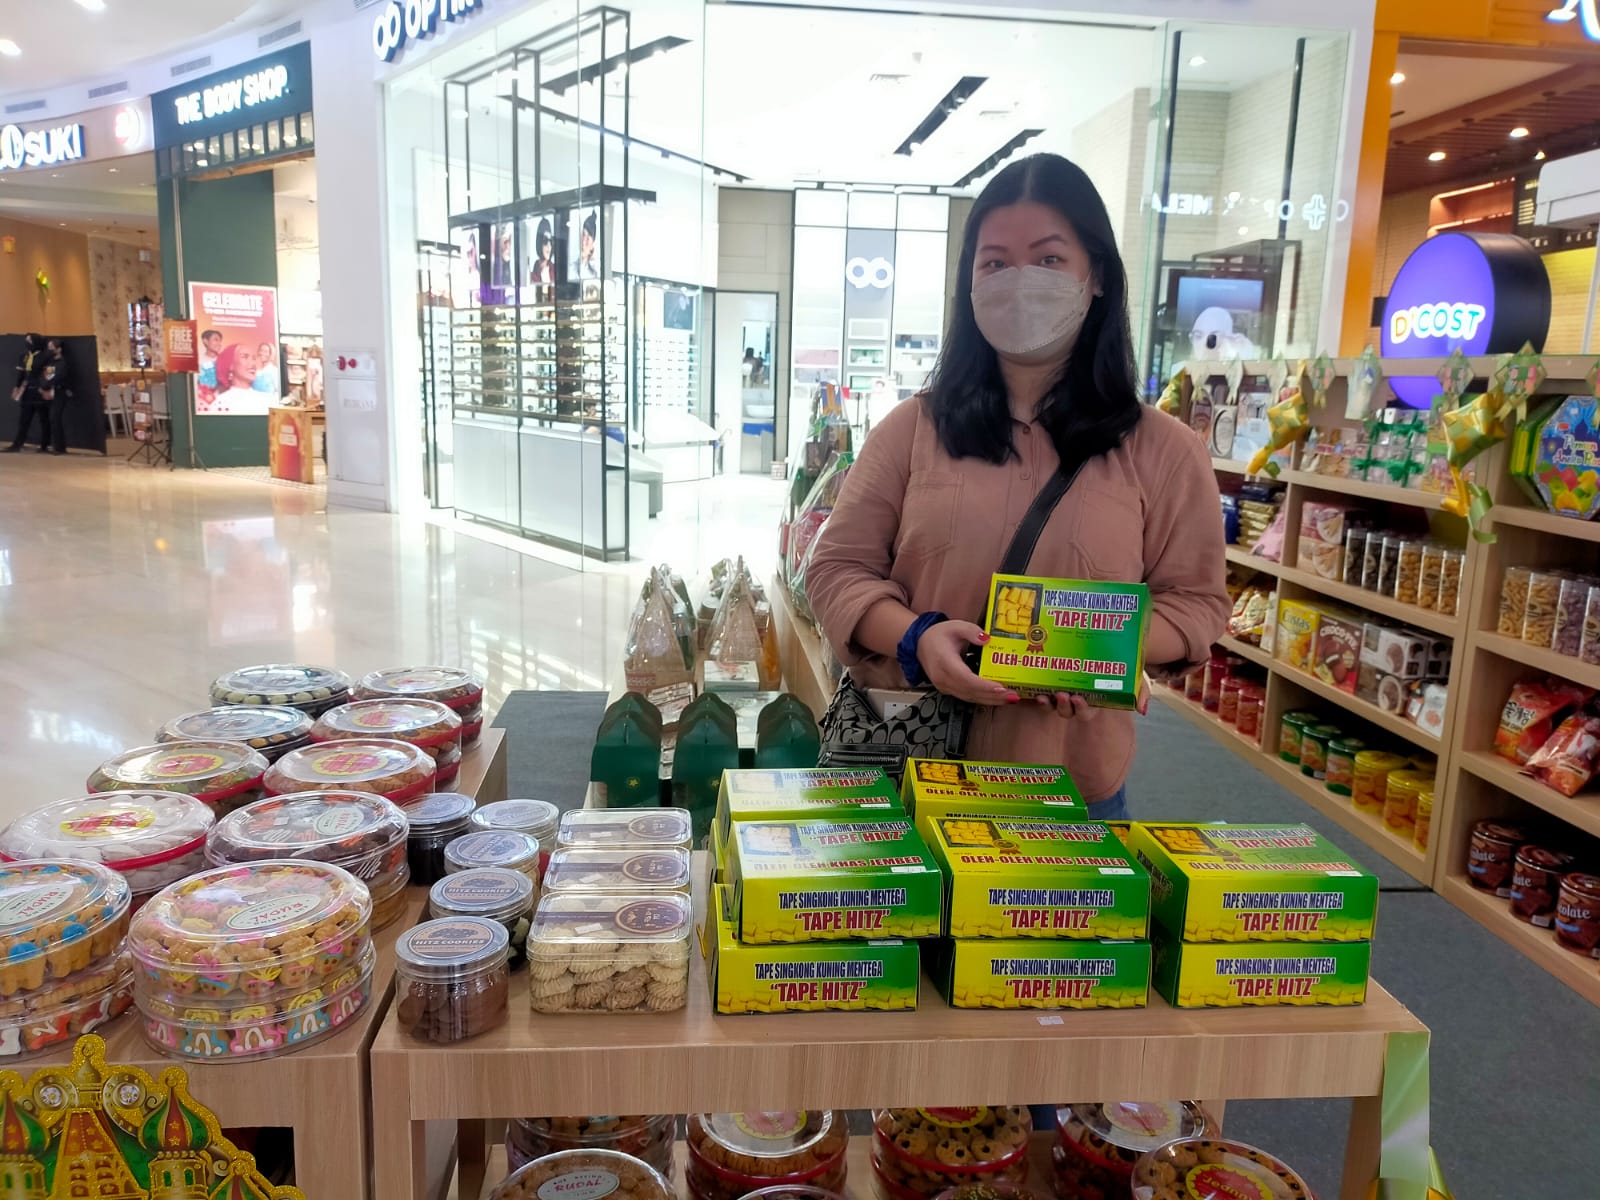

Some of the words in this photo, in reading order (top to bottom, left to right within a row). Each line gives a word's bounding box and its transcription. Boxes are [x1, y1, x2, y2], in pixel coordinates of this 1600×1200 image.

[175, 92, 203, 125] THE
[203, 79, 242, 118] BODY
[1392, 304, 1483, 342] D'COST
[1044, 590, 1057, 606] TAPE
[1058, 591, 1087, 608] SINGKONG
[1088, 593, 1109, 610] KUNING
[1110, 594, 1138, 612] MENTEGA
[992, 652, 1048, 669] OLEH-OLEH
[1051, 657, 1081, 672] KHAS
[1083, 659, 1127, 676] JEMBER
[926, 788, 987, 798] OLEH-OLEH
[989, 792, 1023, 800] KHAS
[1025, 794, 1072, 802] JEMBER
[801, 826, 815, 835] TAPE
[816, 824, 851, 834] SINGKONG
[852, 823, 877, 832] KUNING
[877, 821, 912, 831] MENTEGA
[996, 822, 1012, 831] TAPE
[1012, 823, 1049, 832] SINGKONG
[1049, 823, 1076, 833] KUNING
[1075, 824, 1109, 834] MENTEGA
[961, 855, 1034, 865] OLEH-OLEH
[1036, 856, 1073, 866] KHAS
[1076, 857, 1129, 867] JEMBER
[779, 893, 798, 909] TAPE
[798, 891, 838, 908] SINGKONG
[840, 890, 869, 907] KUNING
[870, 888, 906, 906] MENTEGA
[988, 888, 1007, 906] TAPE
[1007, 889, 1047, 906] SINGKONG
[1049, 889, 1078, 906] KUNING
[1078, 889, 1114, 906] MENTEGA
[1223, 893, 1239, 908] TAPE
[1239, 893, 1279, 909] SINGKONG
[1279, 893, 1308, 909] KUNING
[1309, 892, 1344, 909] MENTEGA
[755, 963, 774, 980] TAPE
[774, 962, 815, 979] SINGKONG
[816, 962, 846, 978] KUNING
[846, 961, 883, 978] MENTEGA
[991, 959, 1009, 975] TAPE
[1009, 959, 1049, 976] SINGKONG
[1049, 959, 1079, 976] KUNING
[1080, 959, 1115, 976] MENTEGA
[1216, 959, 1233, 974] TAPE
[1234, 958, 1272, 974] SINGKONG
[1273, 958, 1301, 974] KUNING
[1302, 957, 1336, 974] MENTEGA
[554, 1179, 602, 1192] RUDAL
